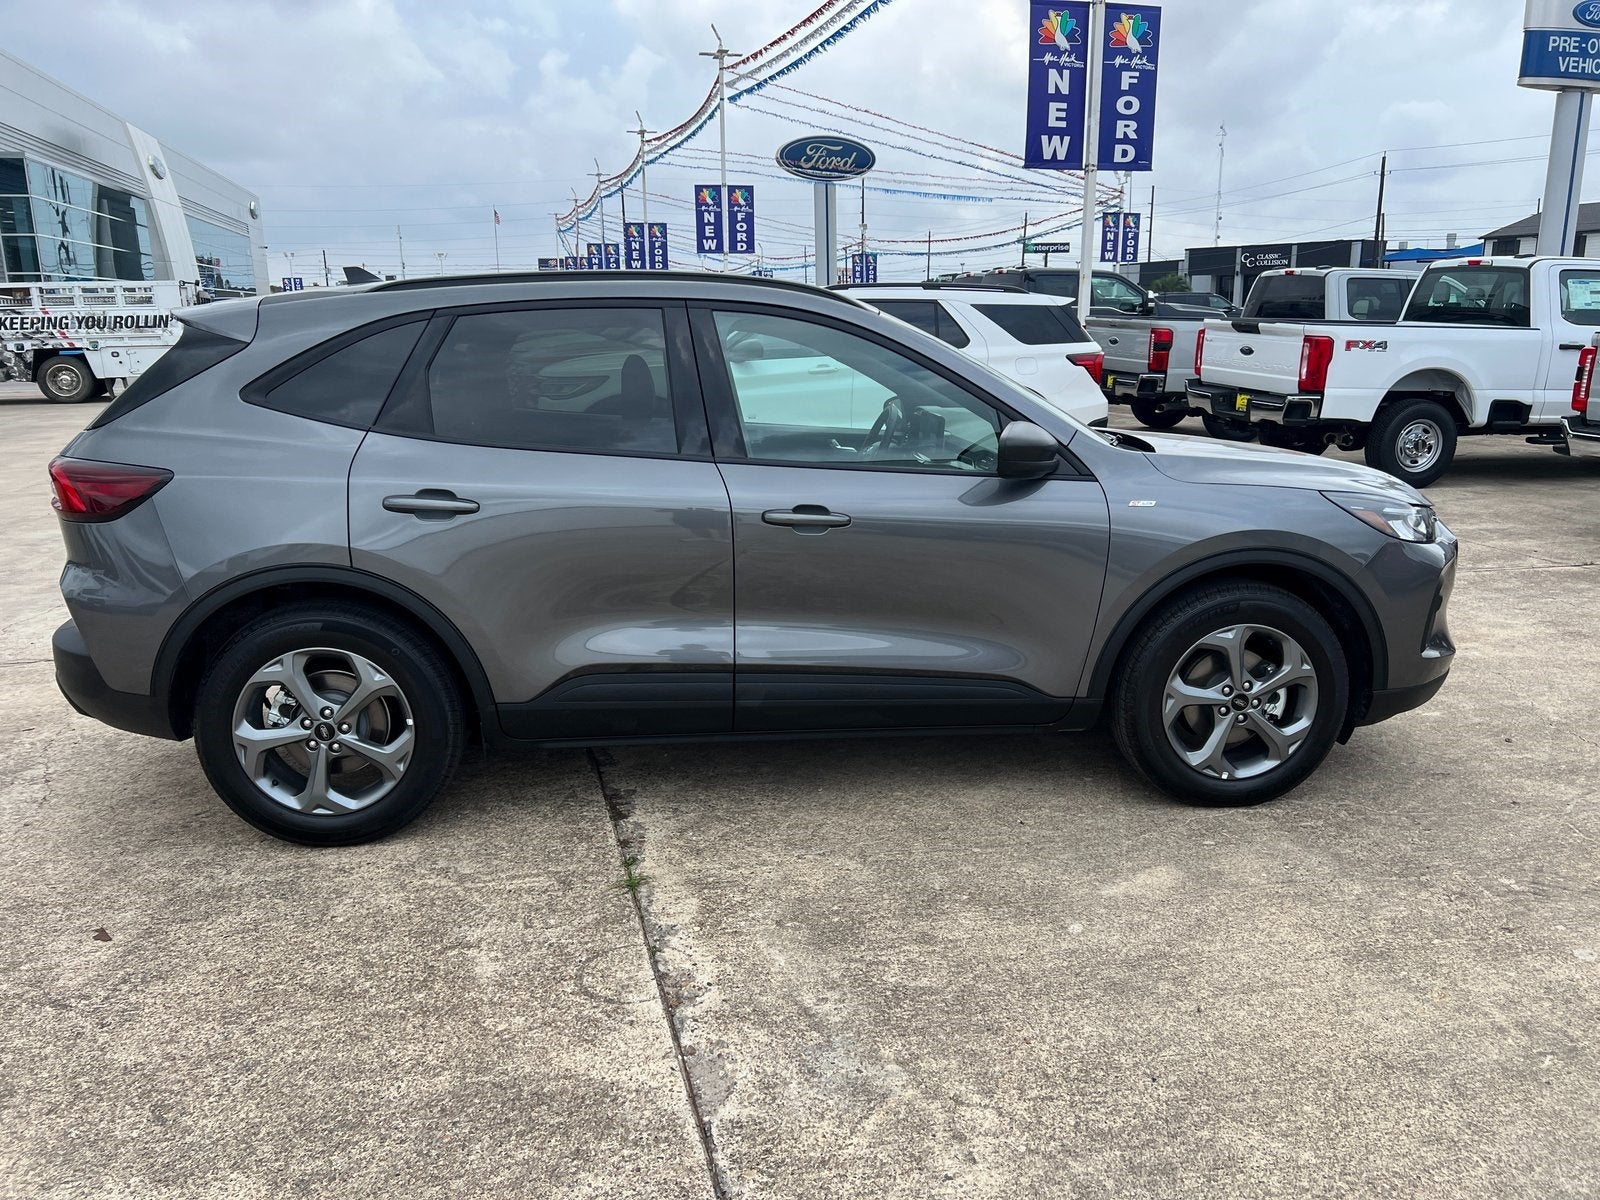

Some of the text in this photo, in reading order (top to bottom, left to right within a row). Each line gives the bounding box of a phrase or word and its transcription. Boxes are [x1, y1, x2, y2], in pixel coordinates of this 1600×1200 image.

[1548, 36, 1600, 54] PRE-O
[1558, 56, 1600, 74] VEHIC
[1041, 69, 1071, 160] NEW
[1113, 71, 1140, 163] FORD
[801, 143, 856, 169] Ford
[703, 212, 717, 250] NEW
[736, 212, 747, 251] FORD
[631, 242, 641, 269] NEW
[654, 242, 663, 269] FORD
[1105, 232, 1114, 260] NEW
[1126, 232, 1134, 260] FORD
[0, 315, 69, 331] KEEPING
[75, 315, 107, 330] YOU
[1345, 340, 1388, 351] FX4
